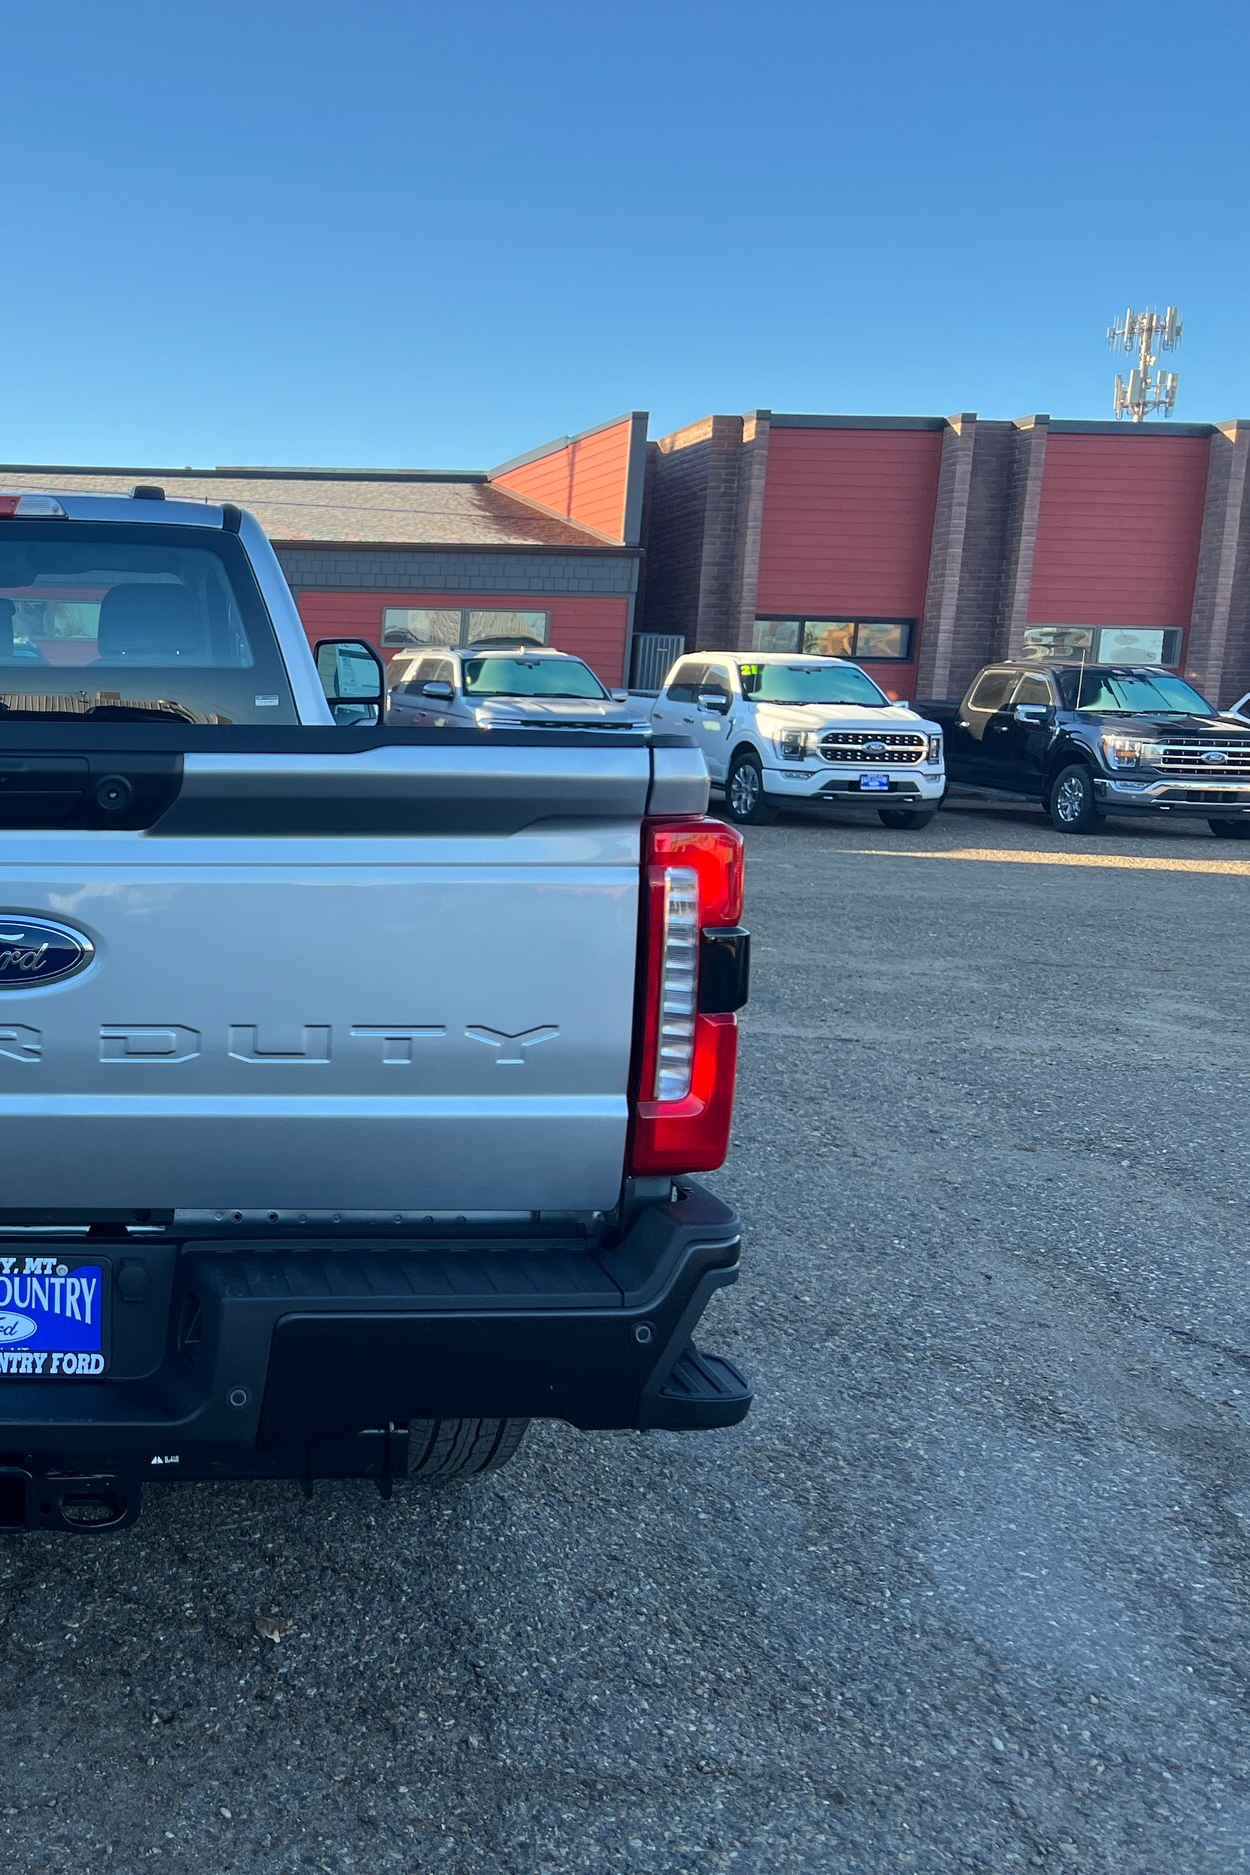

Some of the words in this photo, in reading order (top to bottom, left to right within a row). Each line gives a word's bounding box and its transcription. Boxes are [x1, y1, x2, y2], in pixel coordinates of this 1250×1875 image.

[98, 1023, 561, 1065] DUTY
[23, 1256, 57, 1274] MT
[50, 1352, 105, 1375] FORD
